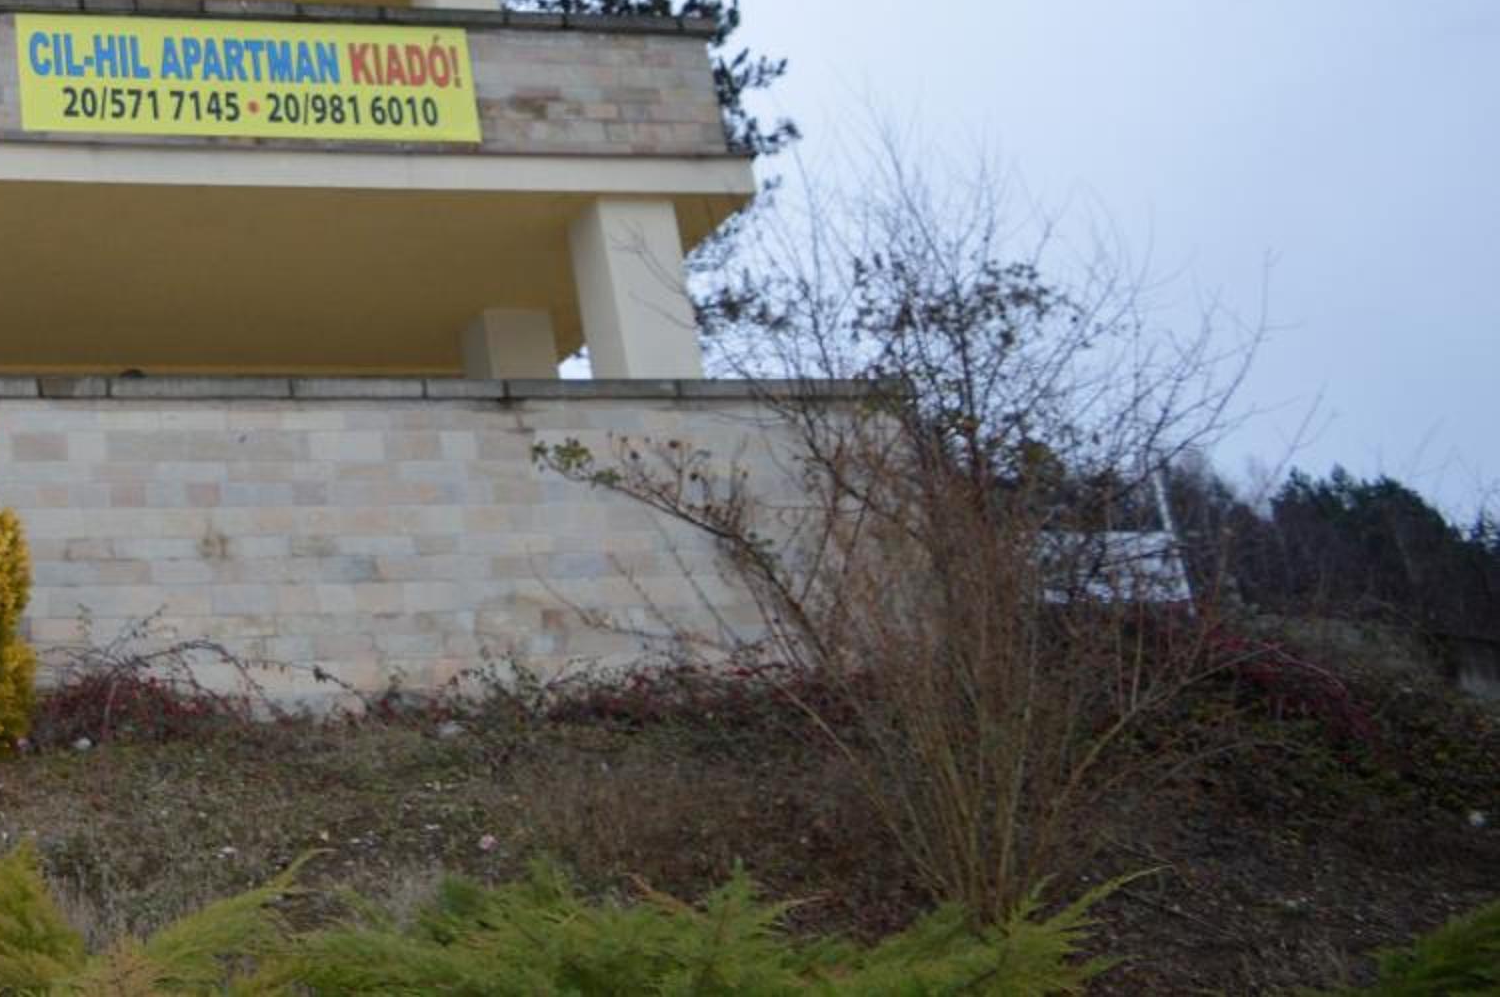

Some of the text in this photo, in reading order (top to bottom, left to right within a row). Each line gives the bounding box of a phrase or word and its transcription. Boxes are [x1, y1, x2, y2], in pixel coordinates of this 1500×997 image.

[29, 32, 462, 87] CIL-HIL APARTMAN KIADÓ!
[63, 87, 439, 127] 20/571 7145 20/981 6010
